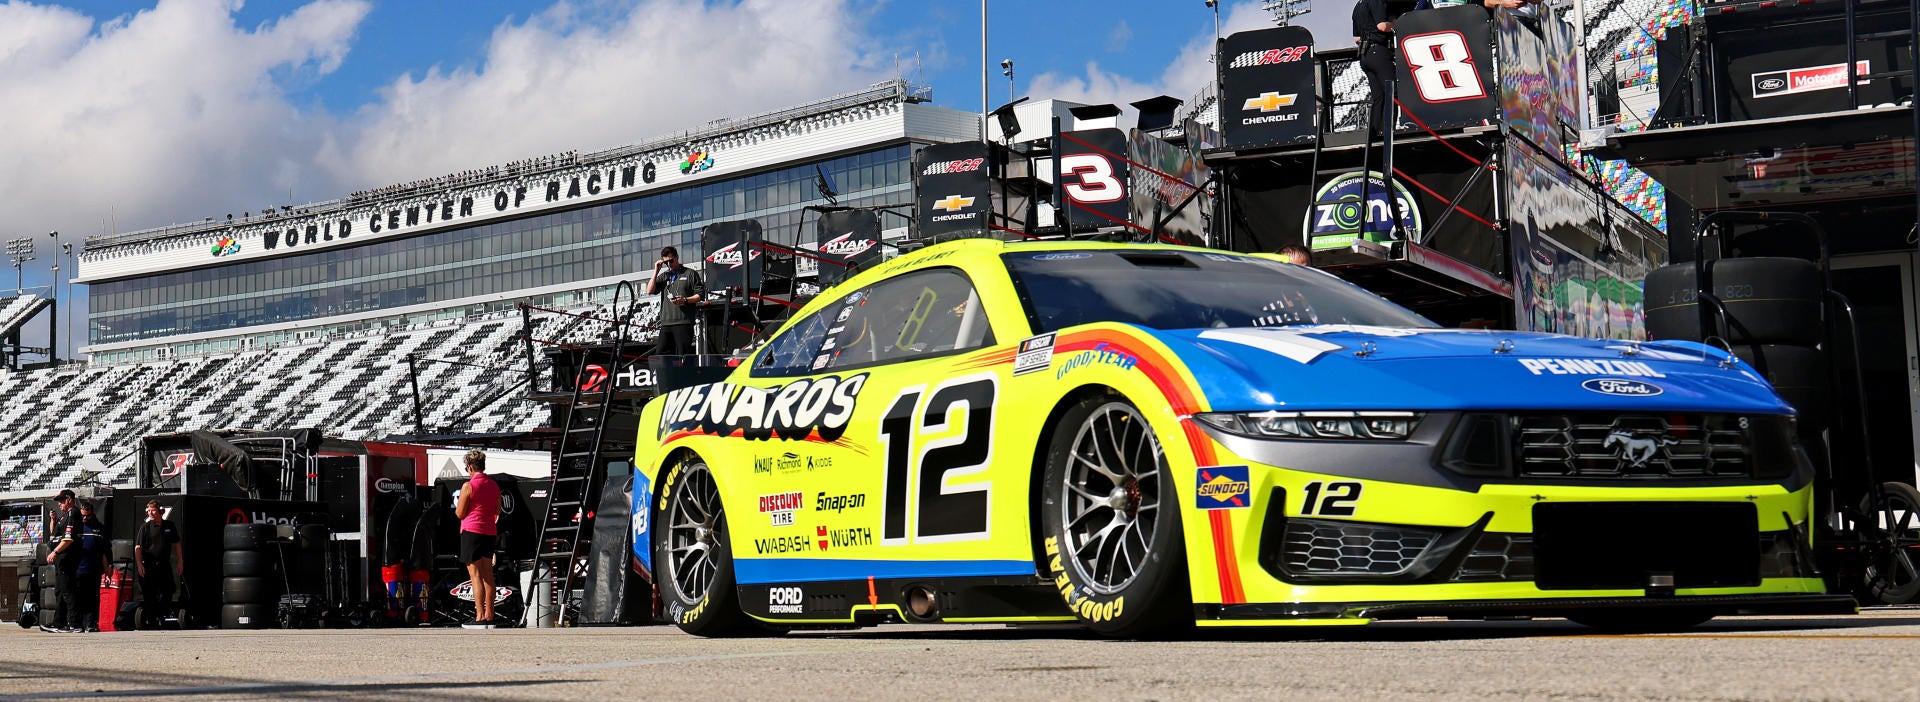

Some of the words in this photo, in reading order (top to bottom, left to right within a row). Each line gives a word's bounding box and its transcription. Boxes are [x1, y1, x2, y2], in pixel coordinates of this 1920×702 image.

[1257, 45, 1308, 66] RCR
[1400, 29, 1487, 104] 8
[1242, 113, 1299, 125] CHEVROLET
[945, 158, 984, 173] RCR
[1060, 153, 1125, 203] 3
[263, 219, 352, 250] WORLD
[369, 196, 474, 233] CENTER
[494, 186, 526, 212] OF
[545, 161, 656, 202] RACING
[932, 213, 977, 222] CHEVROLET
[827, 239, 870, 251] HYAK
[1057, 343, 1137, 380] GOODYEAR
[1517, 358, 1667, 379] PENNZOIL
[754, 454, 773, 476] KNAUF
[777, 457, 802, 470] Richmond
[878, 370, 1000, 547] 12
[1200, 483, 1246, 495] SUNOCO
[1300, 480, 1362, 517] 12
[759, 492, 804, 512] DISCOUNT
[816, 492, 866, 514] Snap-on
[773, 512, 793, 524] TIRE
[755, 536, 811, 555] WABASH
[1044, 535, 1124, 623] GOODYEAR
[769, 587, 803, 605] FORD
[682, 591, 710, 624] EAGLE
[769, 604, 803, 614] PERFORMANCE
